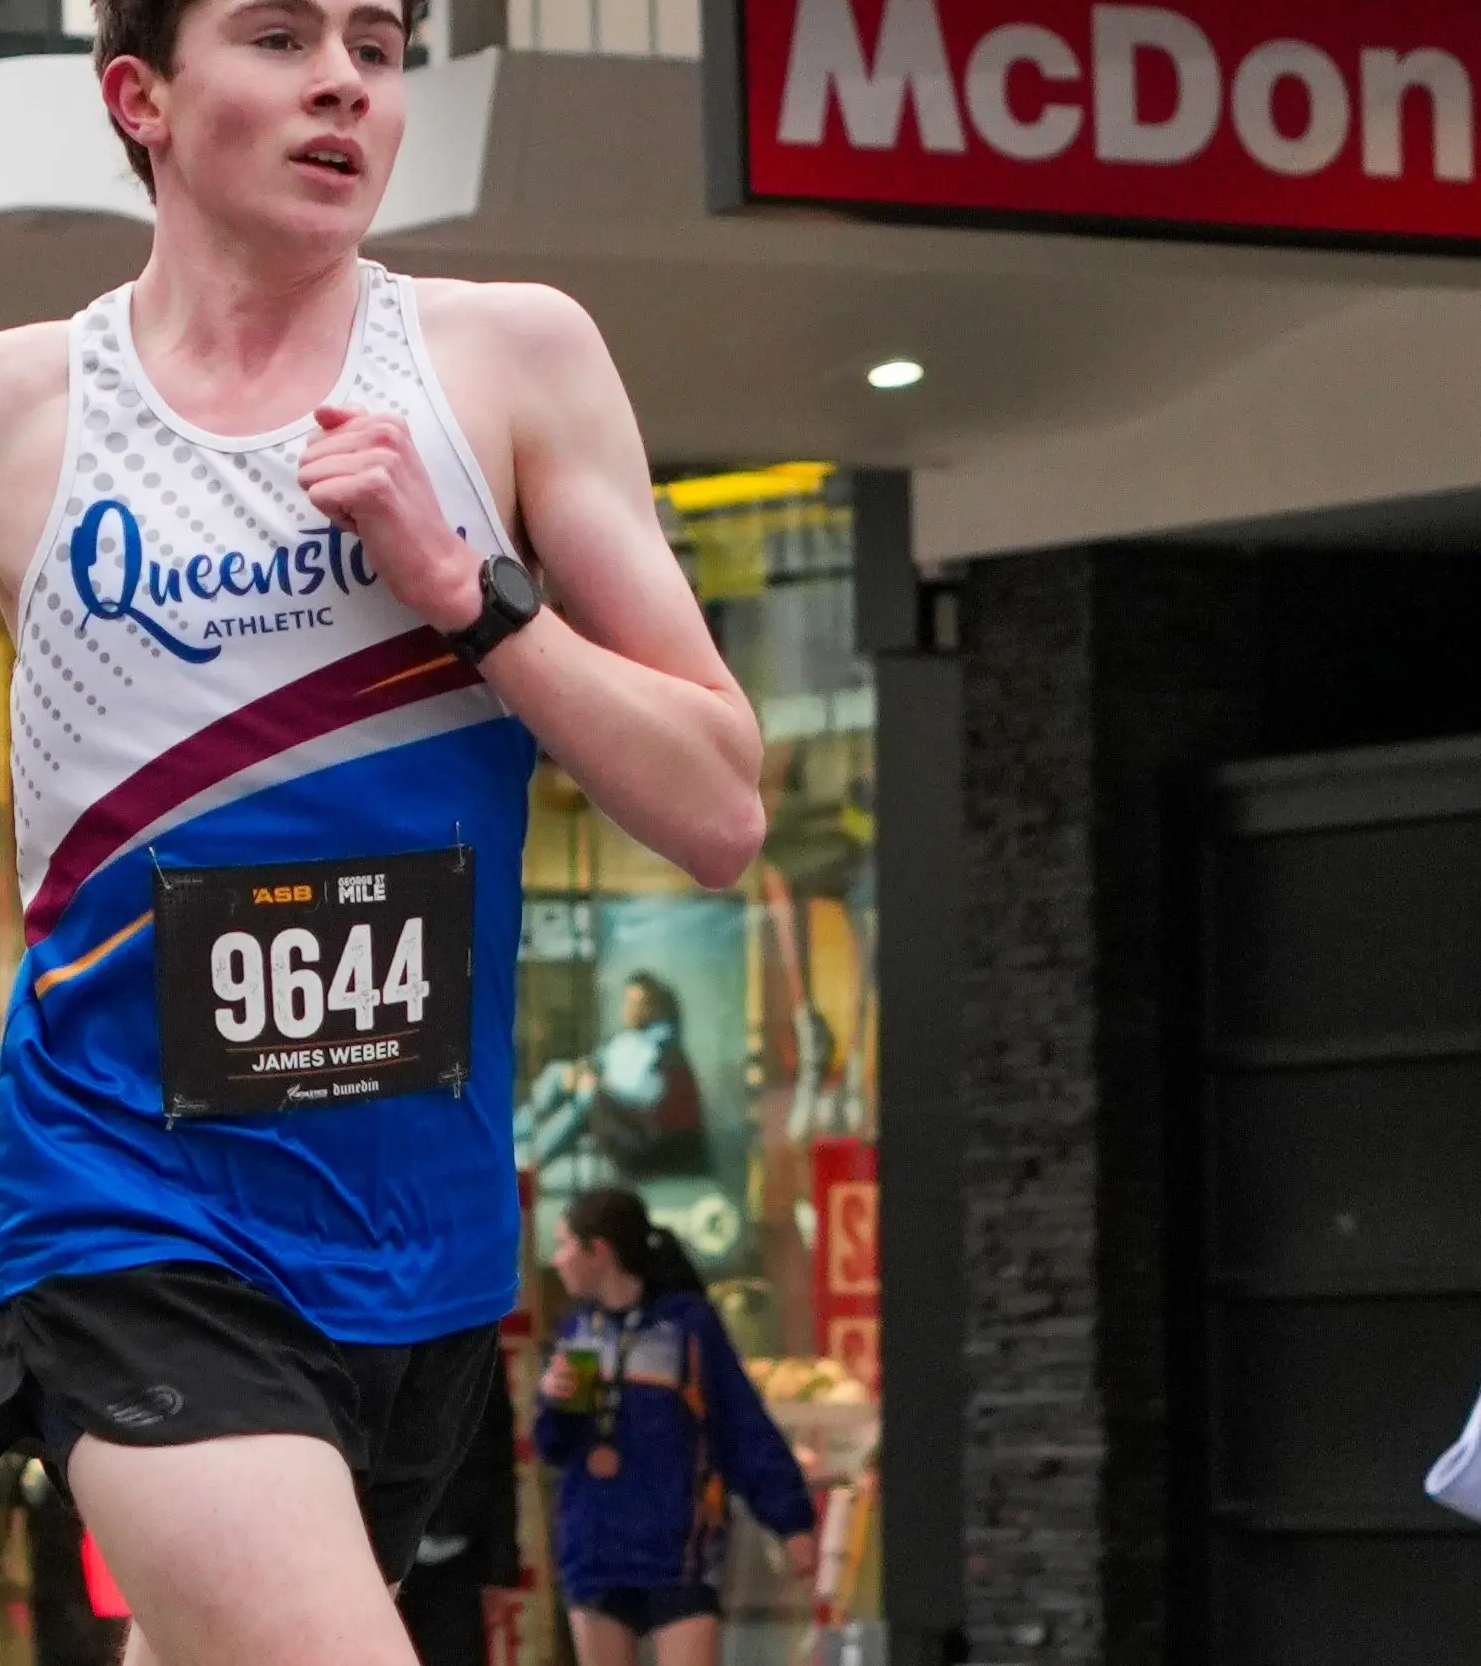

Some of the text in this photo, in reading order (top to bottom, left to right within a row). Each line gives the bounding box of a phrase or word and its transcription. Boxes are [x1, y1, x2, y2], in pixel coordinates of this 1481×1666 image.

[776, 0, 1474, 180] McDon
[203, 606, 334, 639] ATHLETIC
[252, 885, 314, 904] ASB
[338, 884, 386, 904] MILE
[210, 917, 429, 1042] 9644
[252, 1040, 399, 1072] JAMES WEBER
[333, 1078, 379, 1096] dunedin
